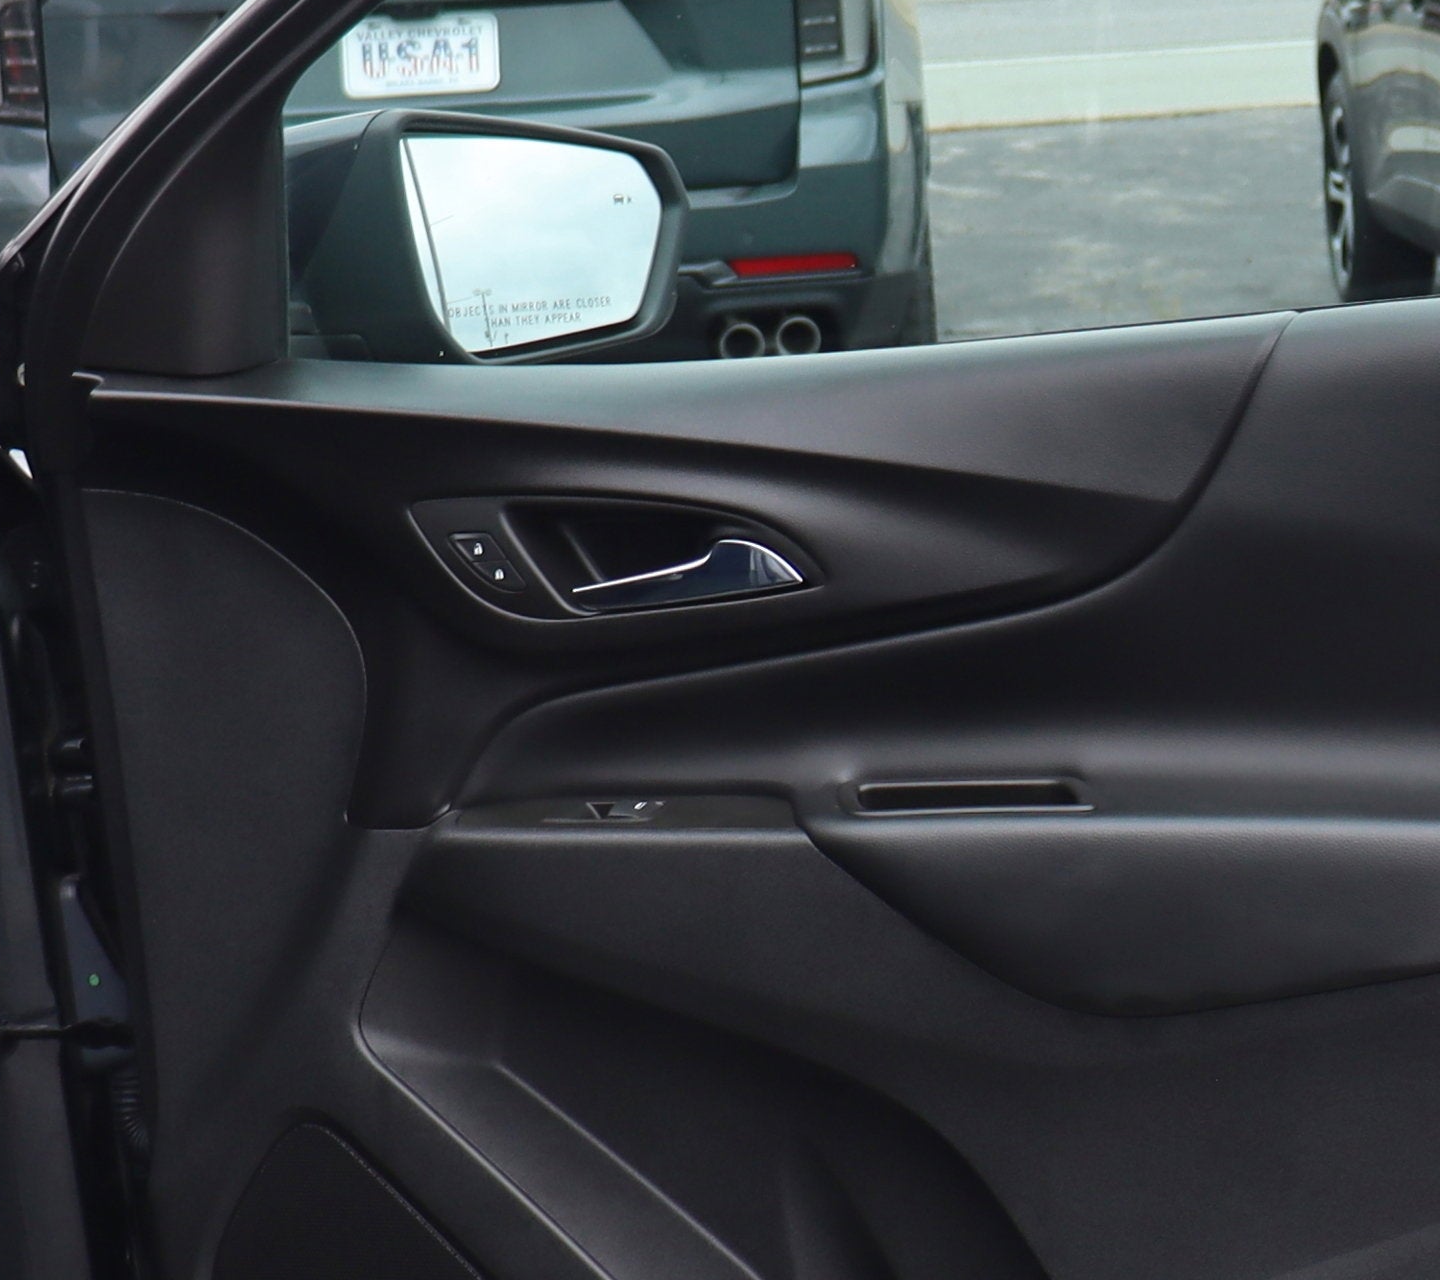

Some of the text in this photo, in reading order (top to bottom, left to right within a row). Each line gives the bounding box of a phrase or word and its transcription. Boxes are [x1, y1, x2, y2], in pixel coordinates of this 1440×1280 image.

[356, 25, 483, 42] VALLEY CHEVROLET
[361, 37, 480, 79] USA1
[499, 303, 508, 314] IN
[512, 300, 548, 313] MIRROR
[553, 298, 570, 310] ARE
[576, 296, 611, 309] CLOSER
[516, 313, 541, 326] THEY
[545, 311, 582, 324] APPEAR
